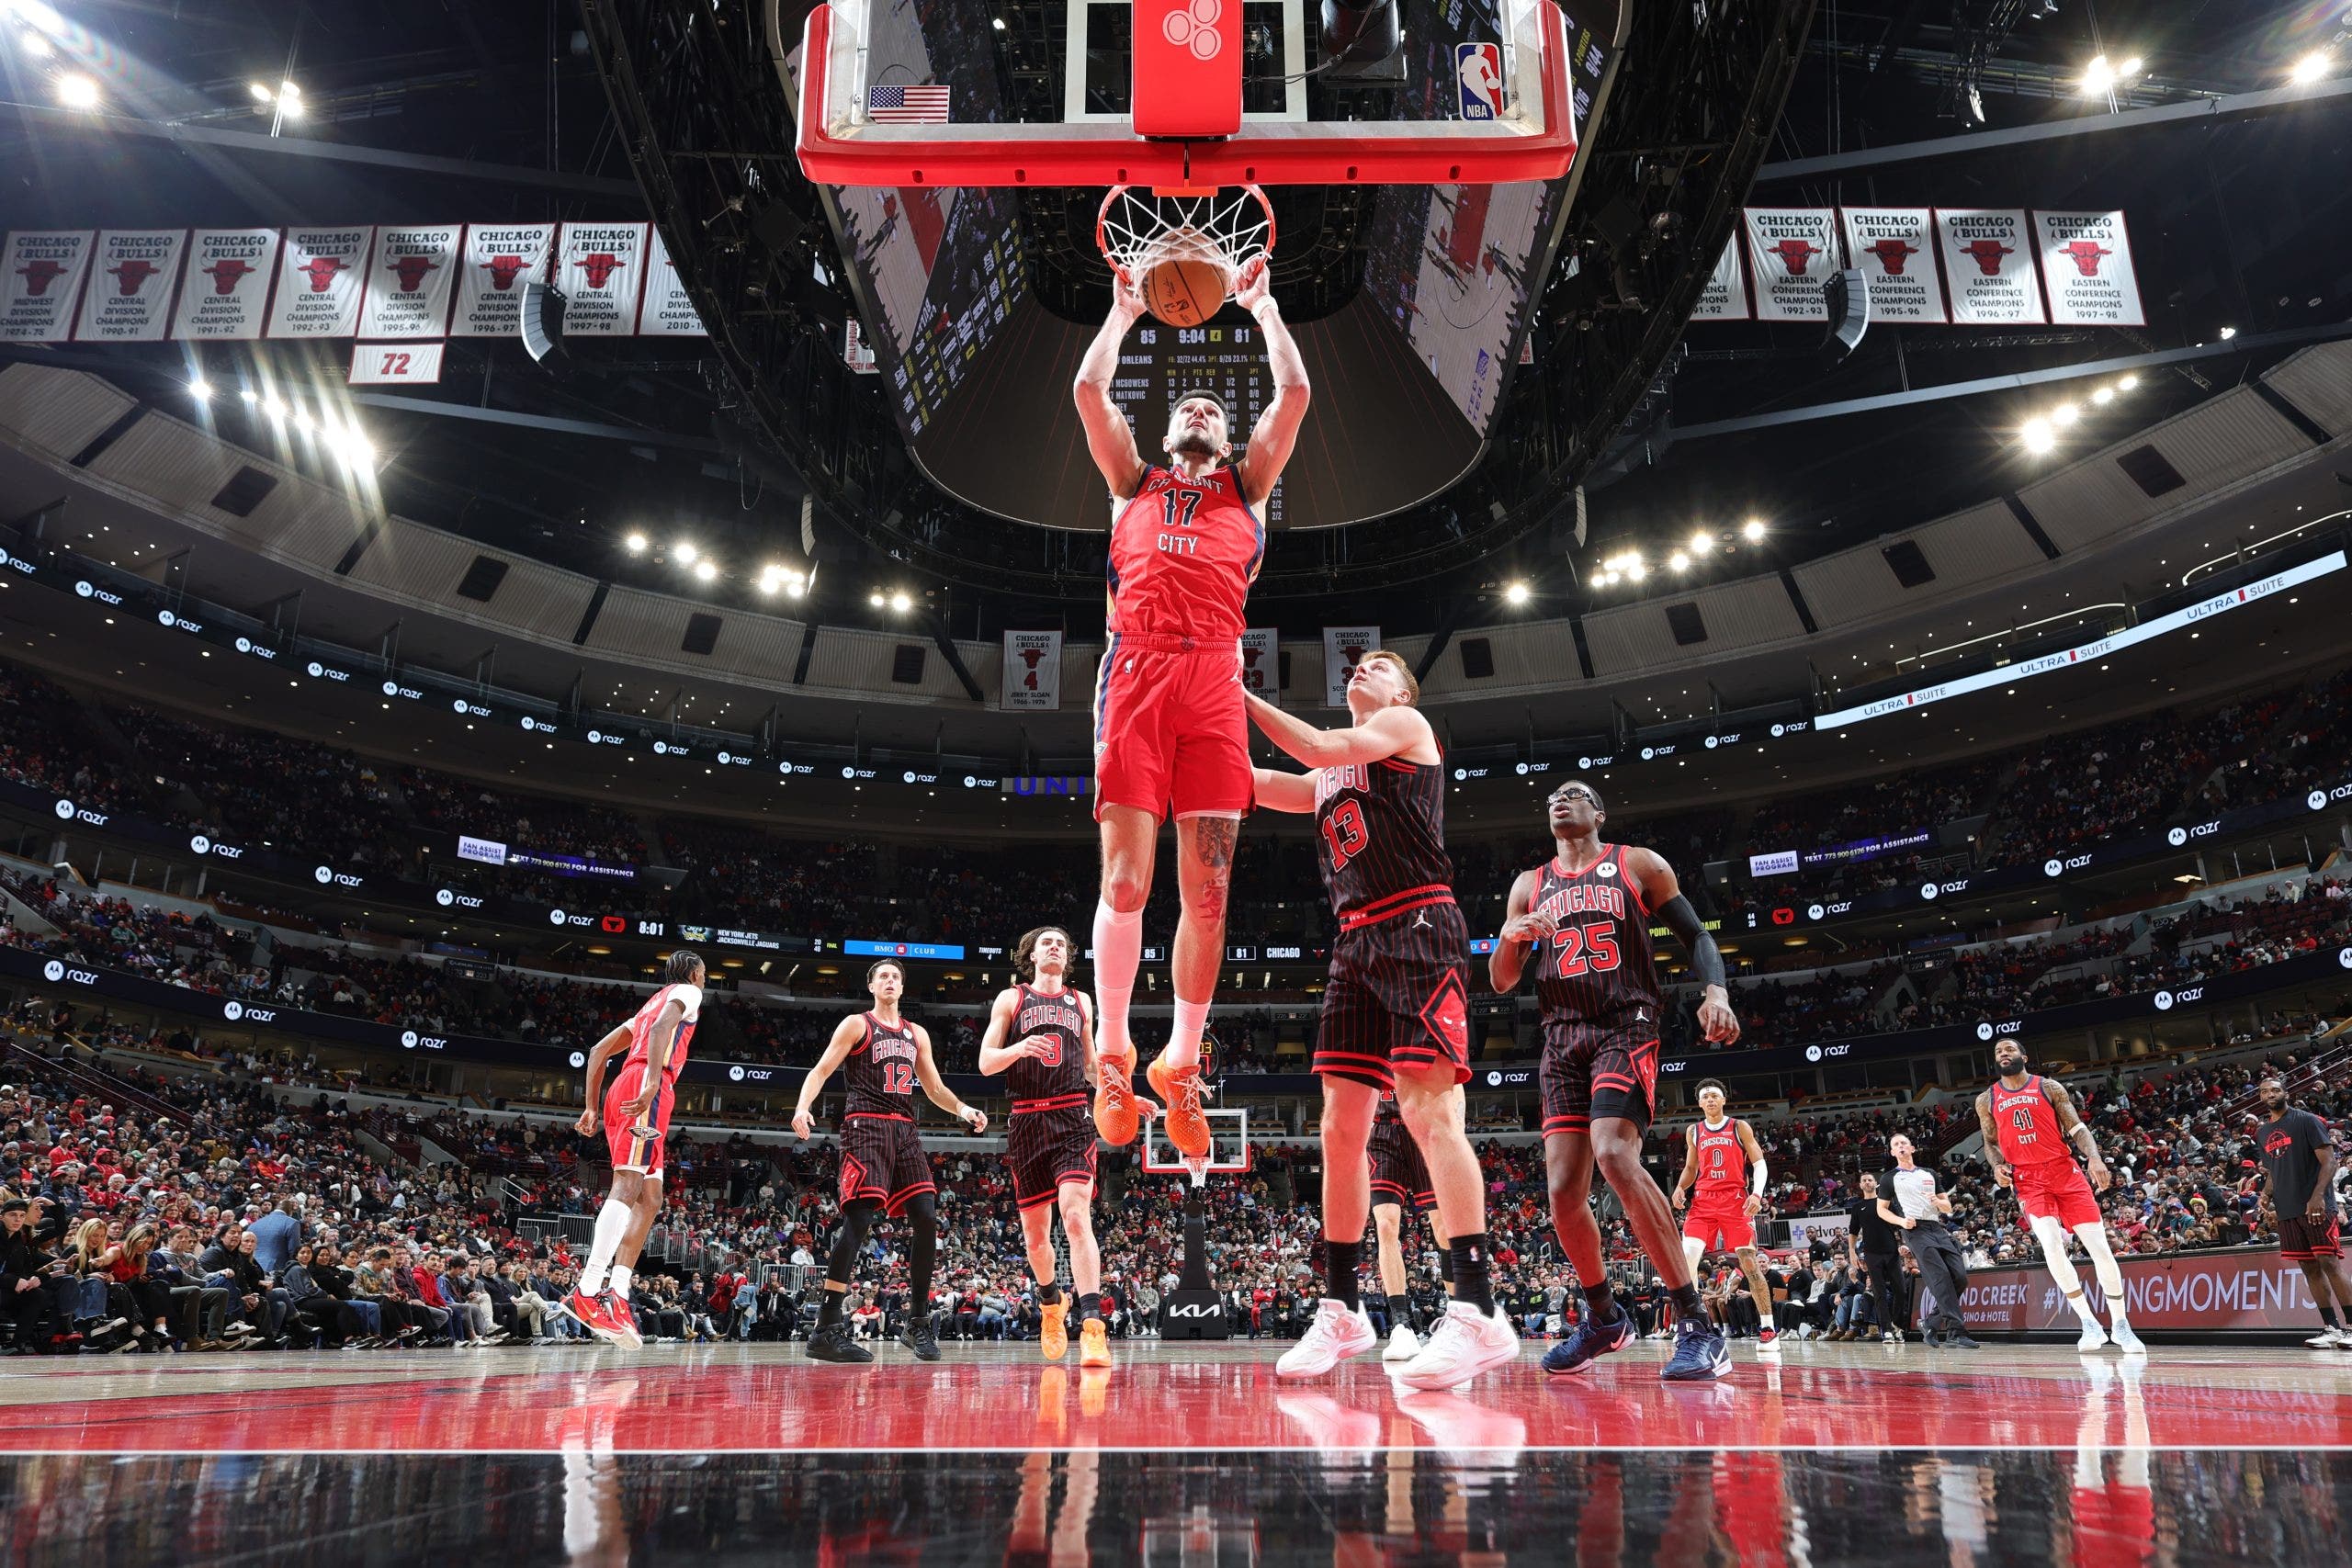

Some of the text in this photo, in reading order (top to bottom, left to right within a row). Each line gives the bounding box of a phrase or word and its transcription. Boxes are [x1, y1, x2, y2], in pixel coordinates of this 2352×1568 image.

[1466, 105, 1488, 118] NBA
[1758, 215, 1823, 226] CHICAGO
[1854, 215, 1920, 226] CHICAGO
[1949, 216, 2015, 227] CHICAGO
[2047, 217, 2113, 228] CHICAGO
[297, 232, 361, 243] CHICAGO
[386, 232, 449, 243] CHICAGO
[479, 230, 542, 241] CHICAGO
[572, 230, 635, 241] CHICAGO
[1770, 228, 1815, 238] BULLS
[1867, 228, 1913, 238] BULLS
[1962, 228, 2007, 239] BULLS
[2060, 229, 2106, 240] BULLS
[17, 236, 80, 247] CHICAGO
[108, 236, 173, 247] CHICAGO
[203, 235, 266, 246] CHICAGO
[306, 244, 351, 255] BULLS
[394, 243, 439, 254] BULLS
[486, 242, 532, 253] BULLS
[581, 241, 626, 252] BULLS
[24, 248, 70, 259] BULLS
[116, 248, 162, 259] BULLS
[210, 247, 257, 258] BULLS
[1780, 276, 1817, 285] EASTERN
[1876, 276, 1915, 284] EASTERN
[1973, 278, 2012, 287] EASTERN
[2072, 278, 2110, 287] EASTERN
[576, 290, 614, 299] CENTRAL
[1771, 286, 1824, 294] CONFERENC
[1869, 286, 1926, 294] CONFERENCE
[1967, 288, 2023, 297] CONFERENCE
[2065, 288, 2121, 298] CONFERENCE
[108, 298, 145, 306] CENTRAL
[299, 293, 335, 301] CENTRAL
[481, 292, 518, 301] CENTRAL
[1871, 296, 1927, 305] CHAMPIONS
[295, 303, 335, 311] DIVISION
[386, 302, 425, 310] DIVISION
[478, 303, 518, 311] DIVISION
[573, 301, 614, 310] DIVISION
[1969, 299, 2025, 308] CHAMPIONS
[2067, 299, 2122, 309] CHAMPIONS
[105, 307, 146, 315] DIVISION
[200, 306, 241, 314] DIVISION
[96, 317, 149, 325] CHAMPIONS
[191, 316, 245, 324] CHAMPIONS
[287, 312, 340, 321] CHAMPIONS
[377, 312, 430, 321] CHAMPIONS
[565, 311, 619, 321] CHAMPIONS
[1140, 328, 1250, 344] 85 9:04 81
[381, 353, 411, 375] 72
[1122, 355, 1152, 365] ORLEANS
[1115, 378, 1149, 388] MCGOWENS
[1115, 390, 1146, 400] MATKOVIC
[1162, 488, 1203, 527] 17
[1158, 533, 1198, 556] CITY
[8, 557, 36, 574] razr
[2187, 577, 2285, 620] ULTRA SUITE
[175, 618, 202, 633] razr
[2020, 640, 2111, 674] ULTRA SUITE
[323, 669, 350, 682] razr
[1023, 671, 1038, 690] 4
[1864, 687, 1946, 716] ULTRA SUITE
[469, 705, 492, 716] razr
[602, 735, 625, 745] razr
[1719, 733, 1741, 744] razr
[731, 756, 752, 765] razr
[1592, 756, 1613, 766] razr
[1468, 768, 1488, 777] razr
[977, 779, 997, 787] razr
[76, 809, 108, 826] razr
[2190, 820, 2221, 838] razr
[1322, 797, 1369, 874] 13
[212, 843, 243, 859] razr
[1804, 853, 1823, 863] TEXT
[1866, 843, 1882, 853] FOR
[1883, 833, 1929, 850] ASSISTANCE
[1755, 856, 1794, 867] FAN ASSIST
[1756, 862, 1794, 872] PROGRAM
[2065, 853, 2092, 870] razr
[589, 865, 634, 877] ASSISTANCE
[334, 874, 363, 887] razr
[1940, 879, 1969, 894] razr
[456, 895, 483, 908] razr
[1826, 901, 1852, 915] razr
[568, 915, 594, 926] razr
[639, 921, 664, 936] 8:01
[729, 930, 745, 939] YORK
[745, 931, 759, 940] JETS
[717, 937, 779, 950] JACKSONVILLE JAGUARS
[874, 944, 935, 955] BMO CLUB
[1144, 949, 1156, 959] 85
[1236, 948, 1247, 958] 81
[1266, 947, 1300, 958] CHICAGO
[1553, 920, 1622, 980] 25
[66, 967, 99, 986] razr
[2177, 987, 2204, 1003] razr
[245, 1008, 277, 1022] razr
[1021, 1005, 1081, 1038] CHICAGO
[1996, 1021, 2022, 1034] razr
[420, 1036, 447, 1049] razr
[1040, 1032, 1063, 1067] 3
[1825, 1044, 1850, 1056] razr
[1660, 1060, 1688, 1073] razr
[746, 1069, 773, 1081] razr
[883, 1062, 912, 1095] 12
[1505, 1073, 1530, 1082] razr
[1997, 1095, 2039, 1113] CRESCENT
[2013, 1107, 2034, 1131] 41
[1701, 1137, 1734, 1151] CRESCENT
[2018, 1132, 2038, 1145] CITY
[1713, 1148, 1724, 1168] 0
[1710, 1169, 1726, 1179] CITY
[1981, 1284, 2027, 1306] CREEK
[1980, 1312, 1985, 1323] &
[1987, 1310, 2010, 1323] HOTEL
